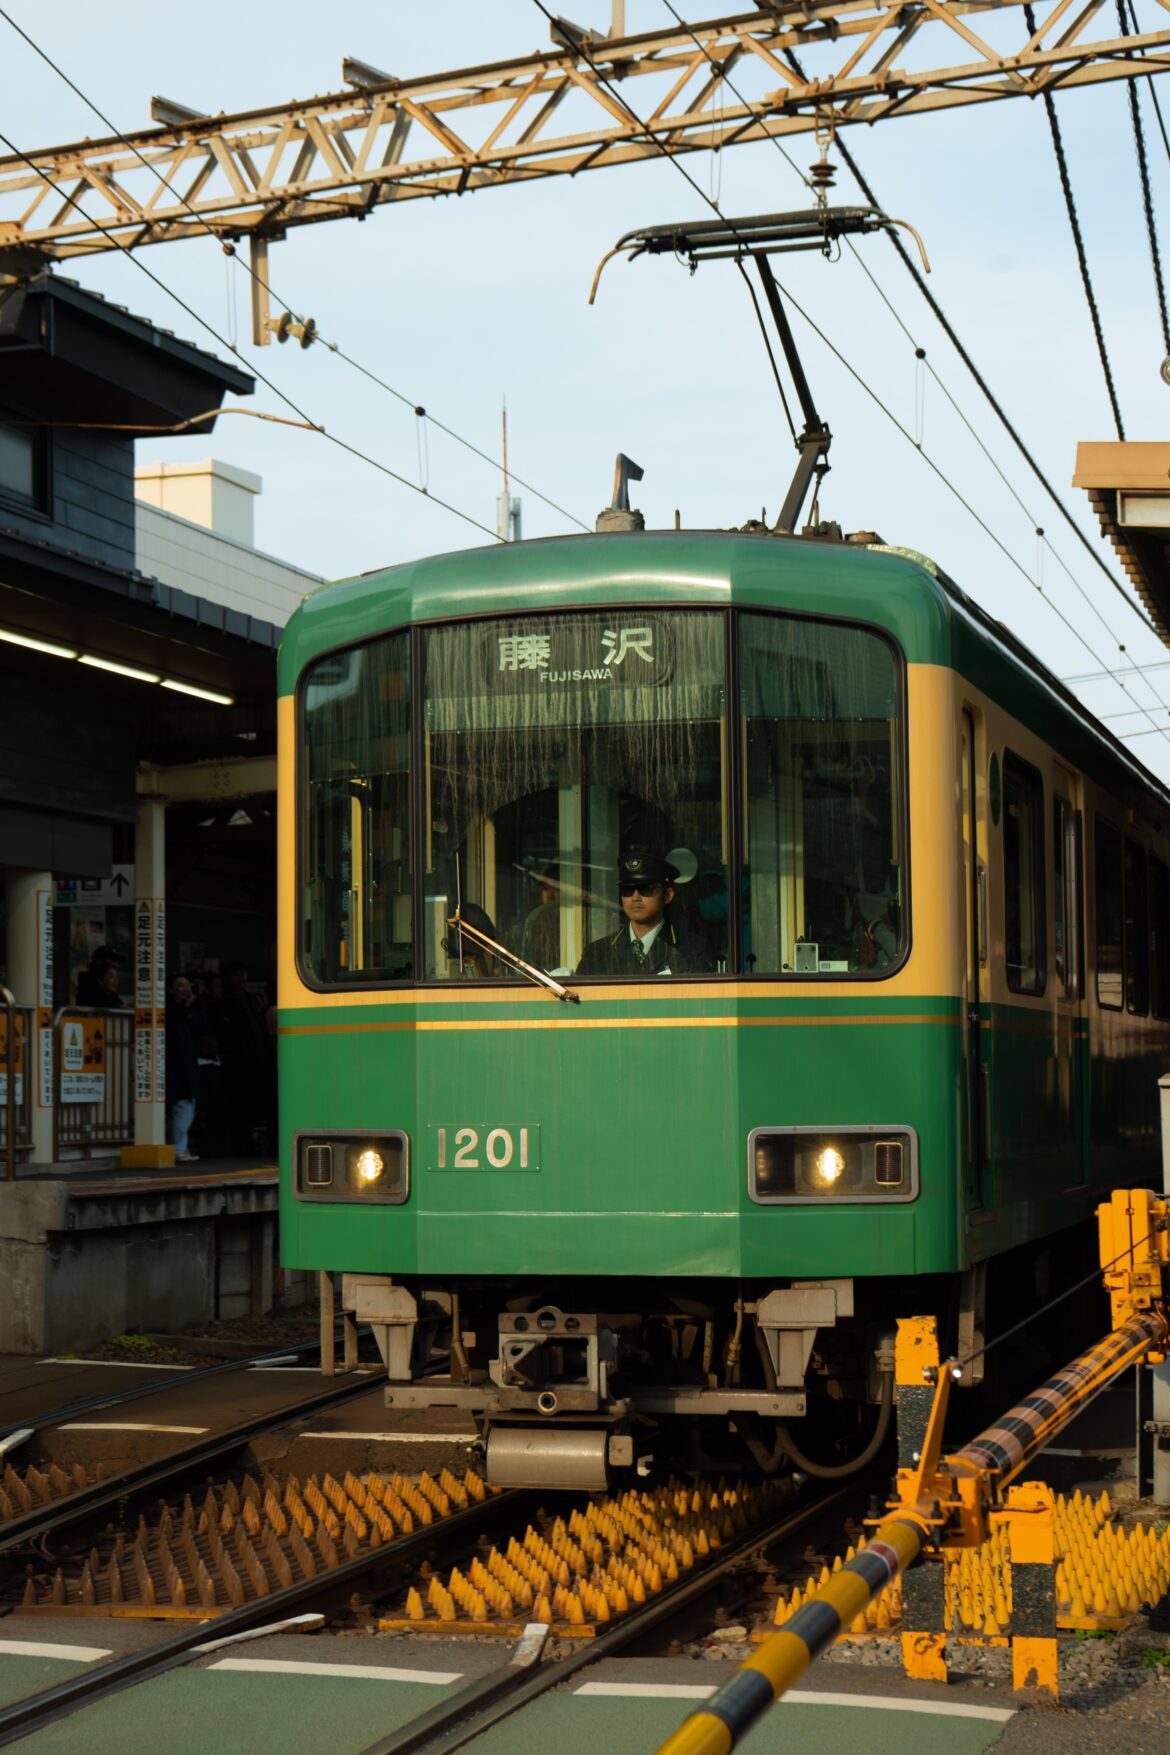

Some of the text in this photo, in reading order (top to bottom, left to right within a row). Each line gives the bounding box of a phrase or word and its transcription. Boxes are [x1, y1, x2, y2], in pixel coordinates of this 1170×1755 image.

[498, 627, 655, 671] 藤沢
[540, 669, 613, 683] FUJISAWA
[138, 915, 151, 982] 足元注意
[438, 1128, 528, 1168] 1201
